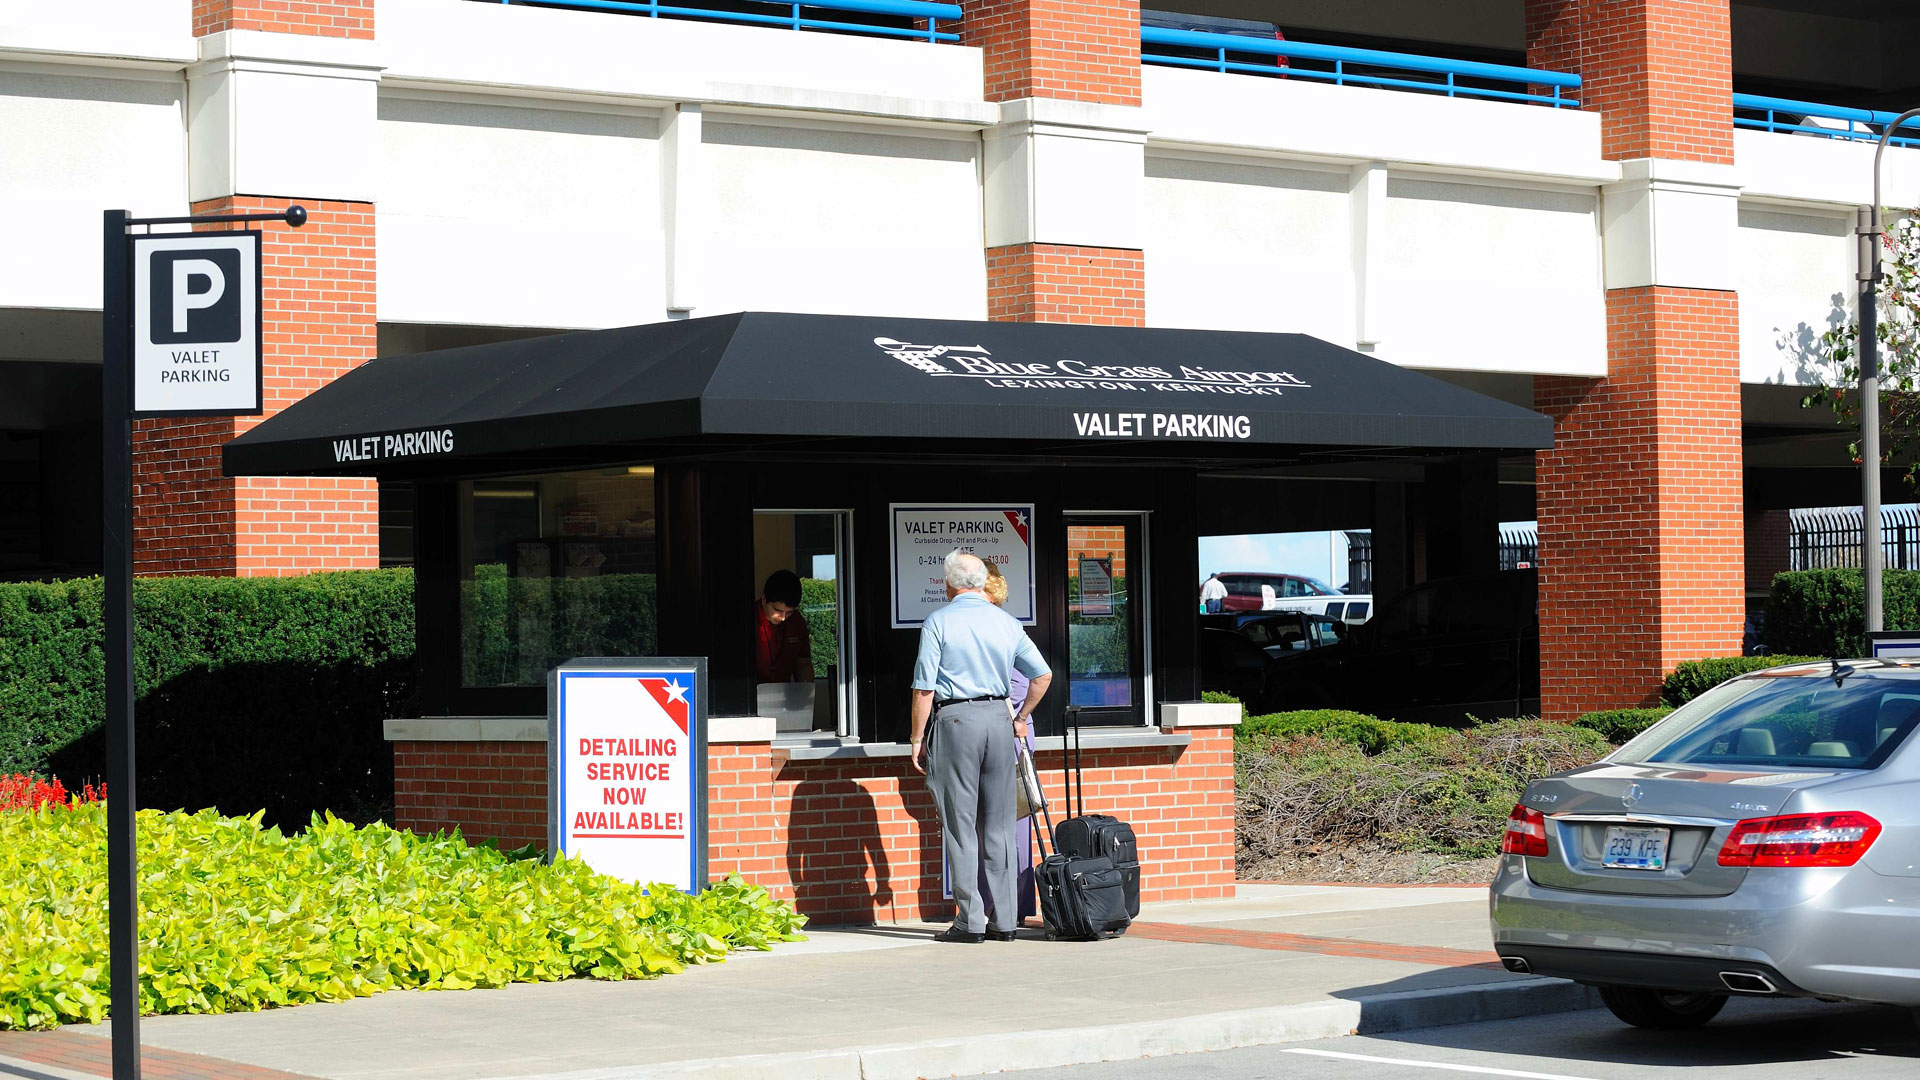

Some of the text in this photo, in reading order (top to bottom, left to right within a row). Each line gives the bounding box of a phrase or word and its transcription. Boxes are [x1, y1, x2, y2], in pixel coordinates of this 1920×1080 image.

[172, 258, 226, 333] P
[171, 350, 220, 364] VALET
[161, 369, 230, 383] PARKING
[946, 355, 1307, 388] Blue Grass Airport
[984, 378, 1284, 396] LEXINGTON, KENTUCKY
[1072, 412, 1252, 440] VALET PARKING
[333, 429, 454, 462] VALET PARKING
[904, 521, 1004, 534] VALET PARKING
[918, 555, 937, 565] 0-24
[929, 577, 945, 585] Thank
[579, 738, 677, 756] DETAILING
[586, 763, 671, 781] SERVICE
[603, 788, 647, 805] NOW
[574, 811, 684, 830] AVAILABLE!
[1609, 837, 1662, 858] 239 KPE
